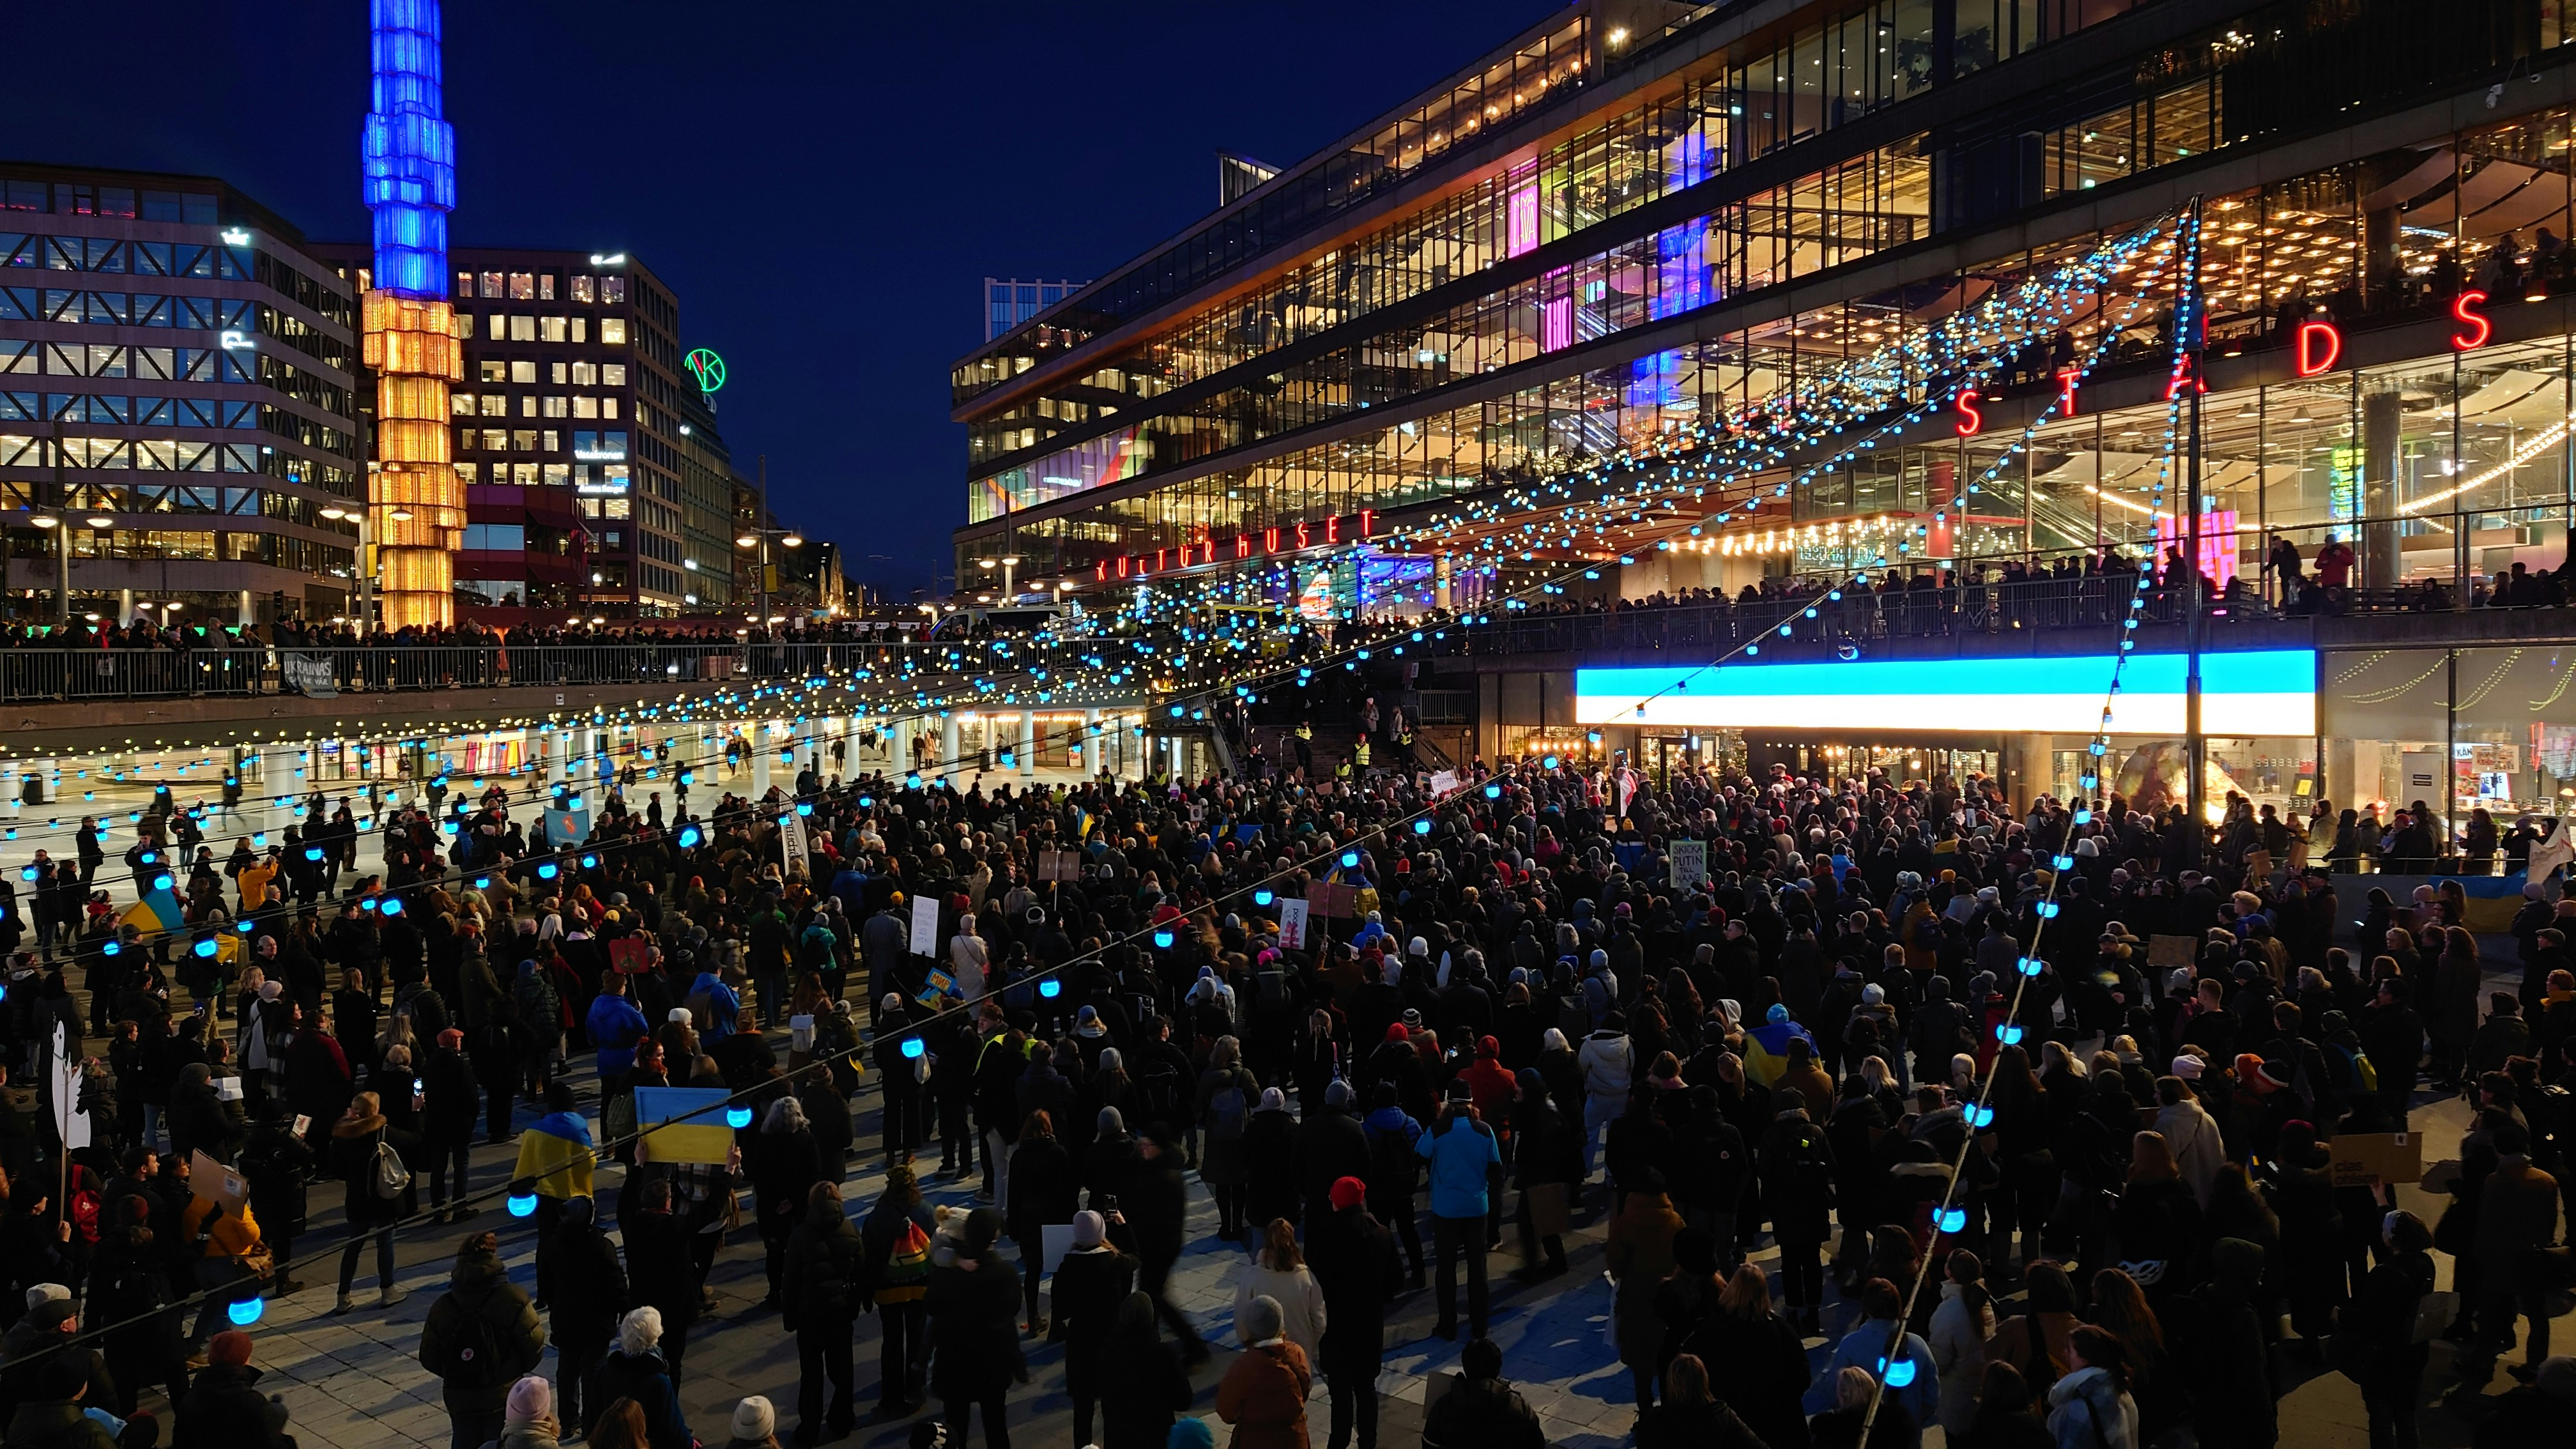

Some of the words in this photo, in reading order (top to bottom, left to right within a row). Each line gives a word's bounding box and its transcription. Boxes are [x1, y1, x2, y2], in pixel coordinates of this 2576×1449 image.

[1514, 192, 1535, 211] NYA
[1514, 205, 1535, 248] LAVA
[575, 450, 624, 459] Vasakronan
[1096, 509, 1373, 581] KULTURHUSET
[284, 661, 331, 676] UKRAINAS
[1673, 844, 1703, 854] SKICKA
[1674, 855, 1703, 866] PUTIN
[1675, 873, 1701, 883] HAAG
[930, 972, 951, 990] МИР
[2334, 1160, 2364, 1172] clas
